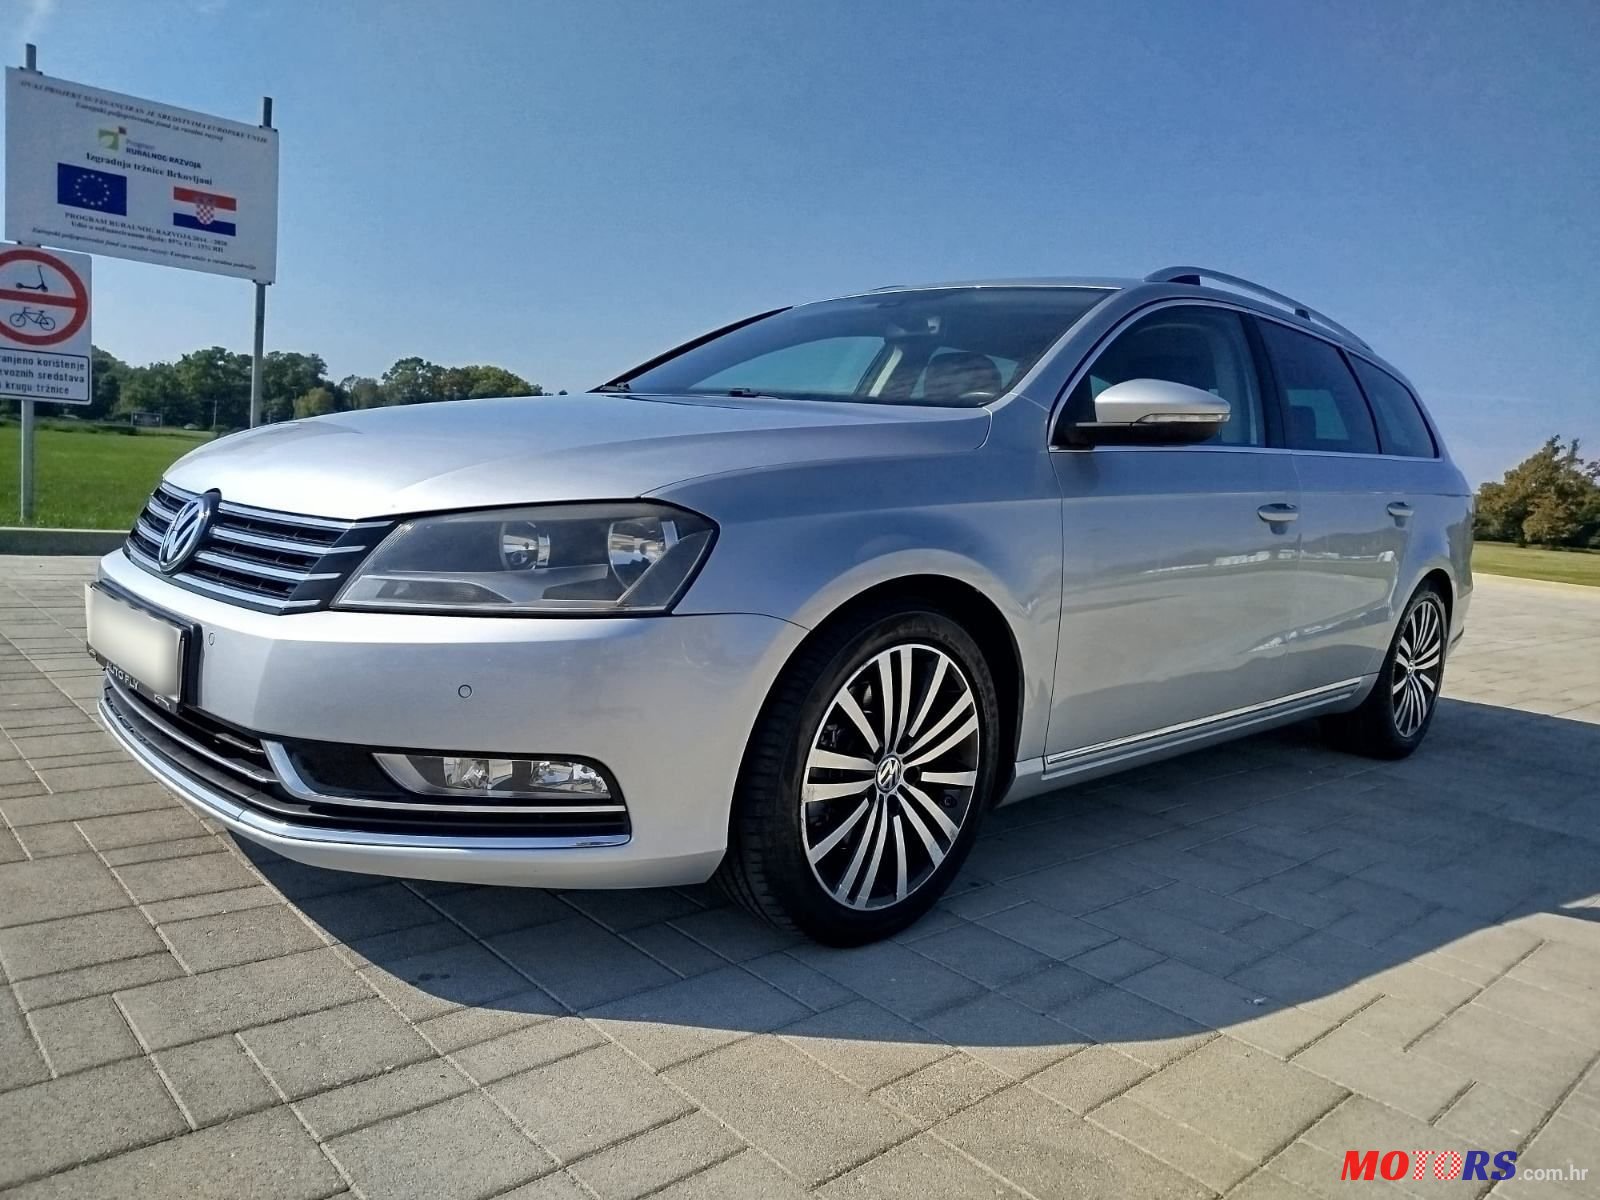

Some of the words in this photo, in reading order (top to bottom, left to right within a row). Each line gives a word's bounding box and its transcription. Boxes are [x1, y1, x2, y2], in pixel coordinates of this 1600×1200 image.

[86, 151, 131, 171] Izgradnja
[134, 161, 164, 177] tržnice
[126, 147, 167, 162] RURALNOG
[169, 156, 201, 170] RAZVOJA
[65, 212, 107, 226] PROGRAM
[156, 229, 191, 240] RAZVOJA
[0, 354, 34, 366] anjeno
[37, 371, 85, 383] sredstava
[6, 381, 32, 393] krugu
[36, 383, 70, 395] tržnice
